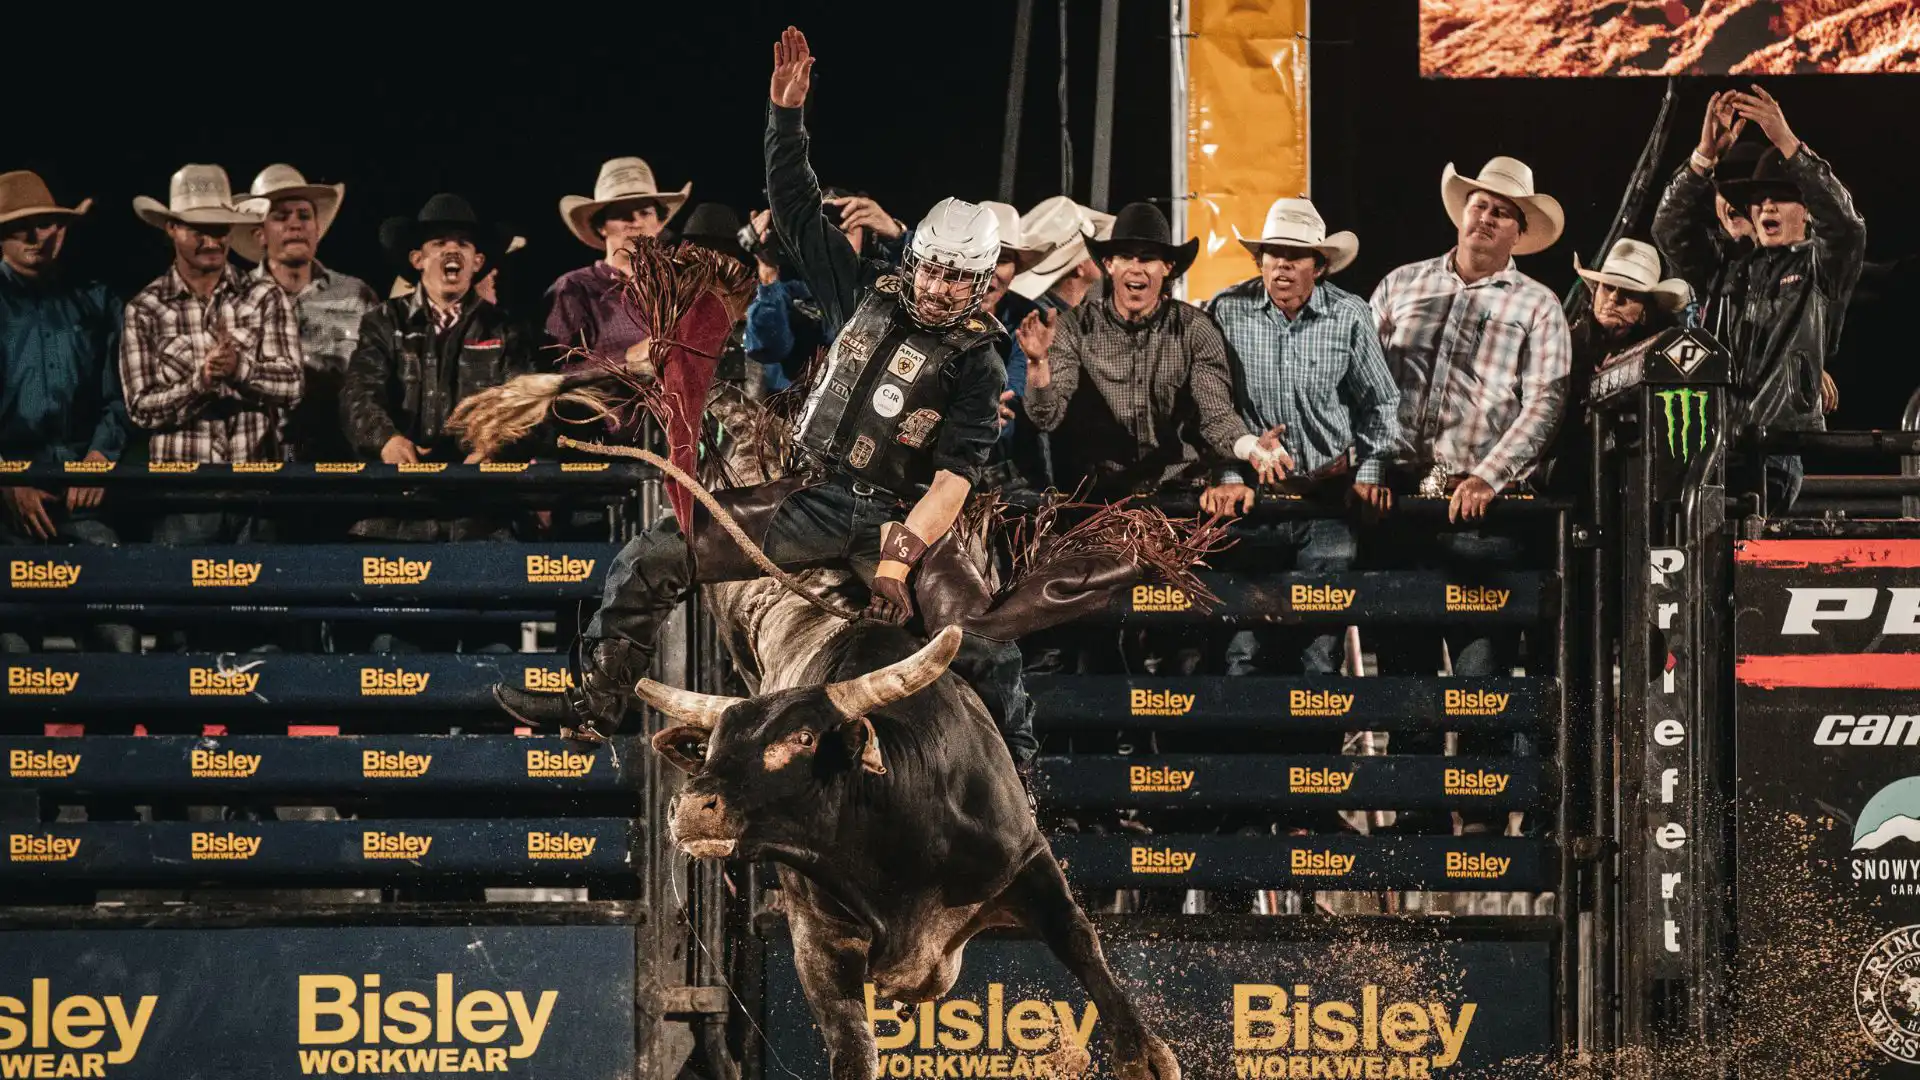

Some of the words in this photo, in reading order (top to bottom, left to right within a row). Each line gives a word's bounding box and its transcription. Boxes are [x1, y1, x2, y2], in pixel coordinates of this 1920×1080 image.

[899, 346, 924, 363] ARIAT
[882, 388, 900, 403] CJR
[893, 532, 908, 548] K
[898, 547, 910, 558] S
[11, 560, 80, 585] Bisley
[192, 559, 261, 583] Bisley
[363, 557, 432, 581] Bisley
[528, 556, 596, 579] Bisley
[1292, 585, 1355, 608] Bisley
[1446, 585, 1510, 608] Bisley
[9, 667, 78, 691] Bisley
[190, 668, 260, 692] Bisley
[361, 668, 430, 692] Bisley
[525, 668, 575, 689] Bisl
[1131, 689, 1195, 712] Bisley
[1290, 690, 1354, 713] Bisley
[1445, 689, 1509, 712] Bisley
[10, 750, 80, 774] Bisley
[192, 750, 261, 774] Bisley
[363, 750, 432, 774] Bisley
[528, 750, 596, 774] Bisley
[1130, 766, 1194, 789] Bisley
[1290, 767, 1354, 790] Bisley
[1445, 769, 1509, 792] Bisley
[10, 834, 80, 858] Bisley
[192, 832, 261, 856] Bisley
[363, 832, 432, 856] Bisley
[528, 832, 596, 856] Bisley
[1131, 847, 1195, 870] Bisley
[1291, 849, 1355, 873] Bisley
[1446, 852, 1510, 875] Bisley
[1852, 859, 1920, 880] SNOWY
[1891, 884, 1920, 895] CARA
[299, 973, 558, 1059] Bisley
[864, 982, 1098, 1055] Bisley
[1233, 983, 1478, 1068] Bisley
[1867, 1008, 1920, 1059] WES
[0, 1053, 106, 1078] WEAR
[299, 1048, 508, 1074] WORKWEAR
[1235, 1055, 1434, 1080] WORKWEAR
